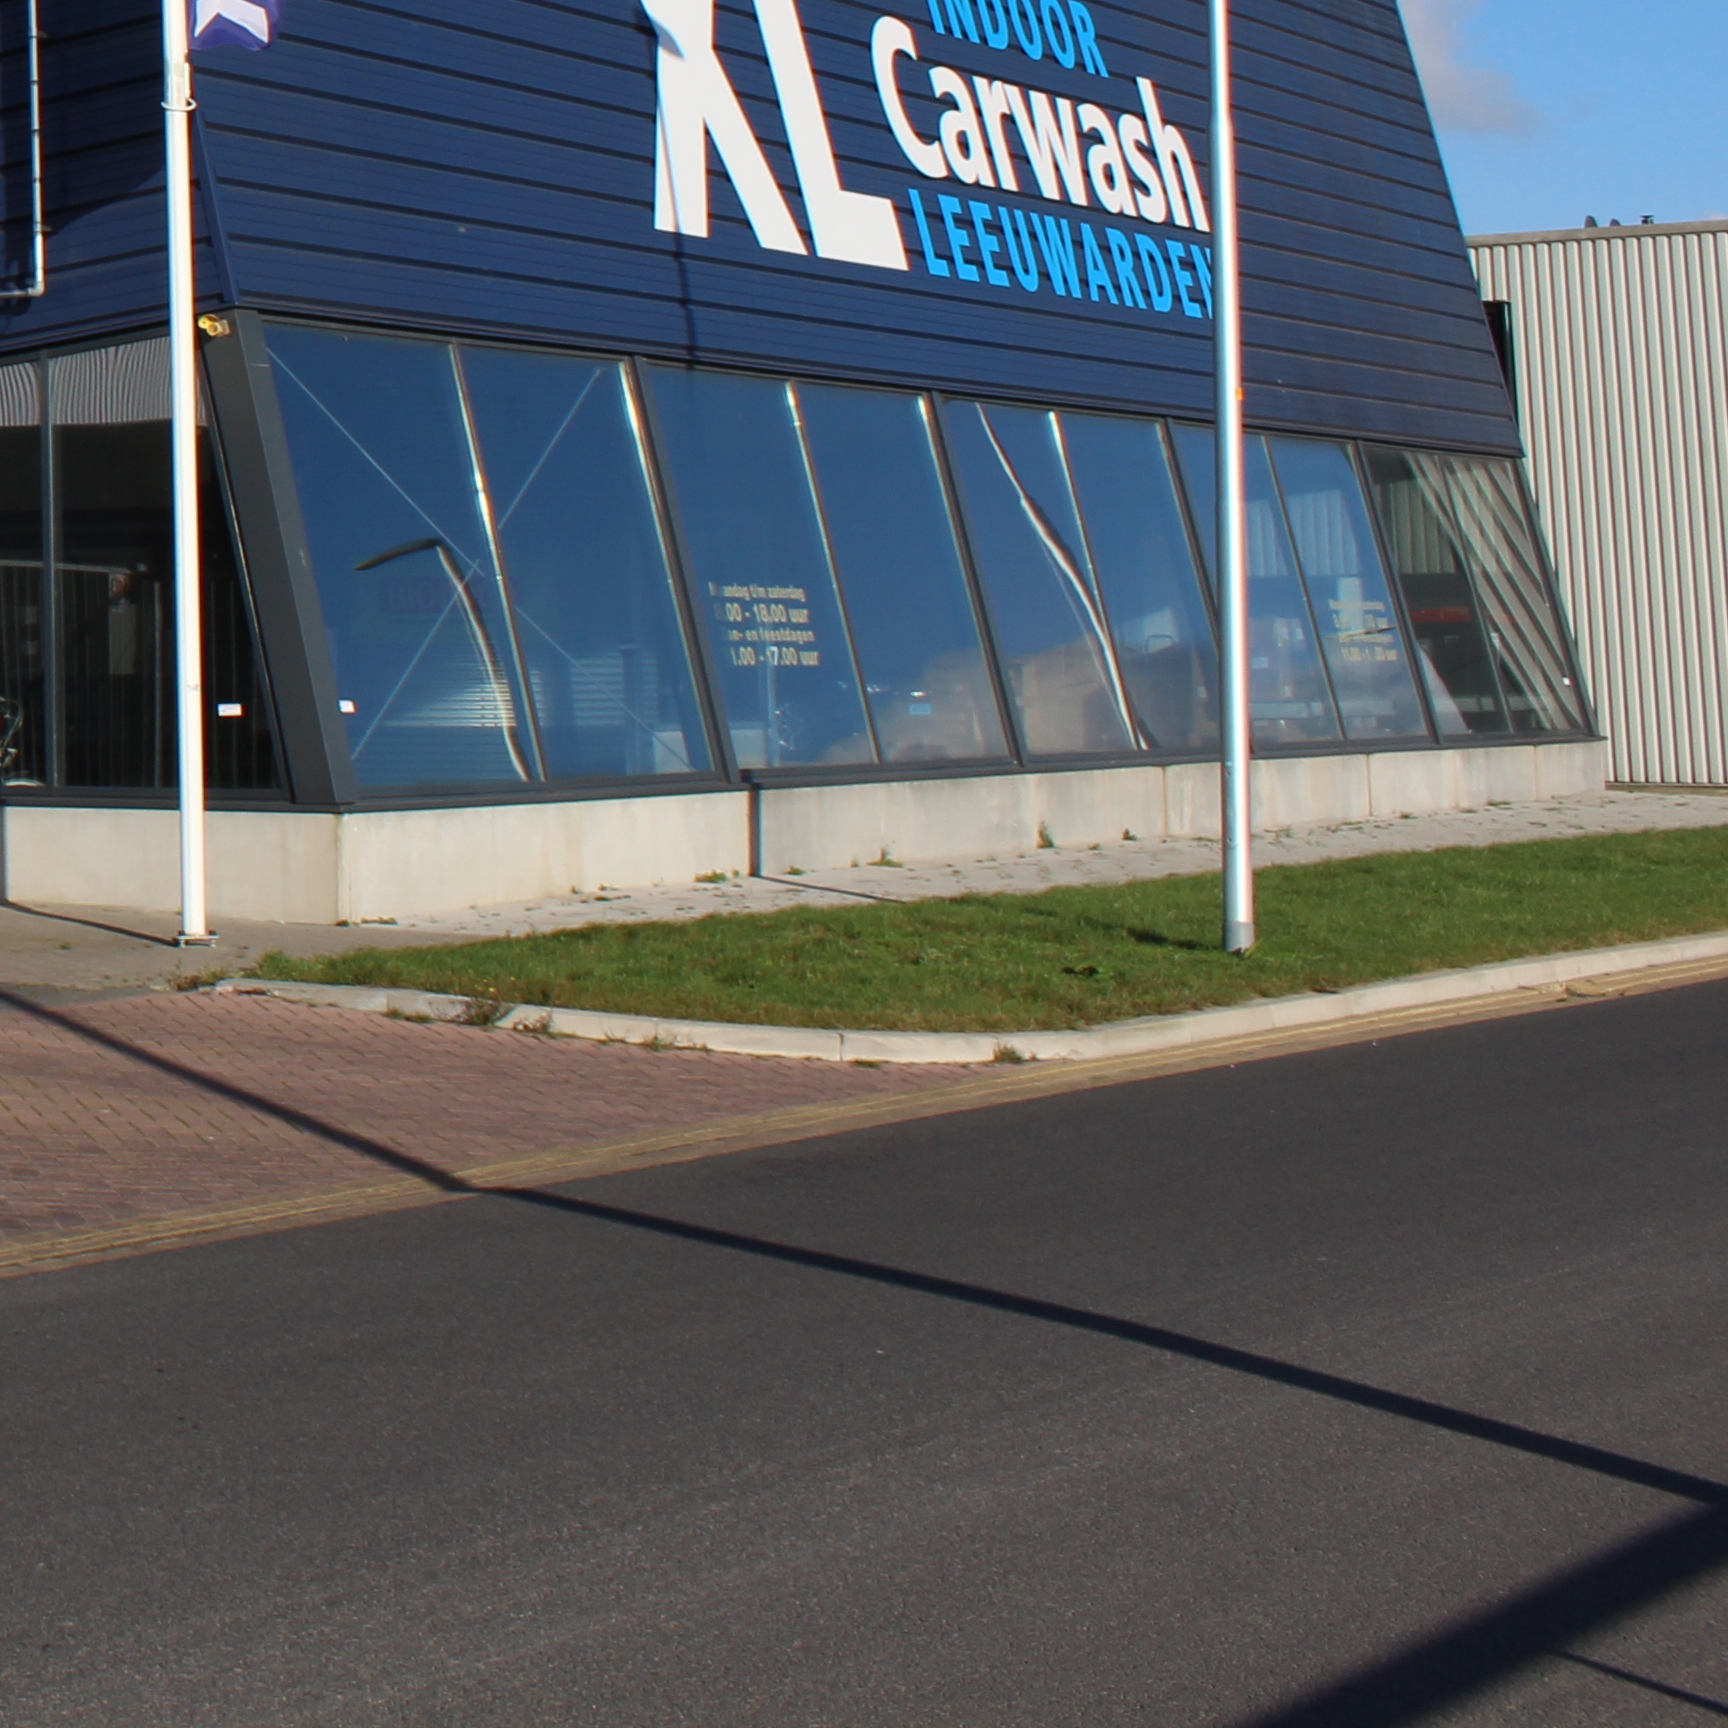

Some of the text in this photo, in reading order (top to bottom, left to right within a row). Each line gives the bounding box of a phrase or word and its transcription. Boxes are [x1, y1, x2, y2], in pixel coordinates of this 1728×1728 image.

[870, 15, 1211, 233] Carwash
[788, 608, 809, 623] uur
[798, 651, 820, 666] uur
